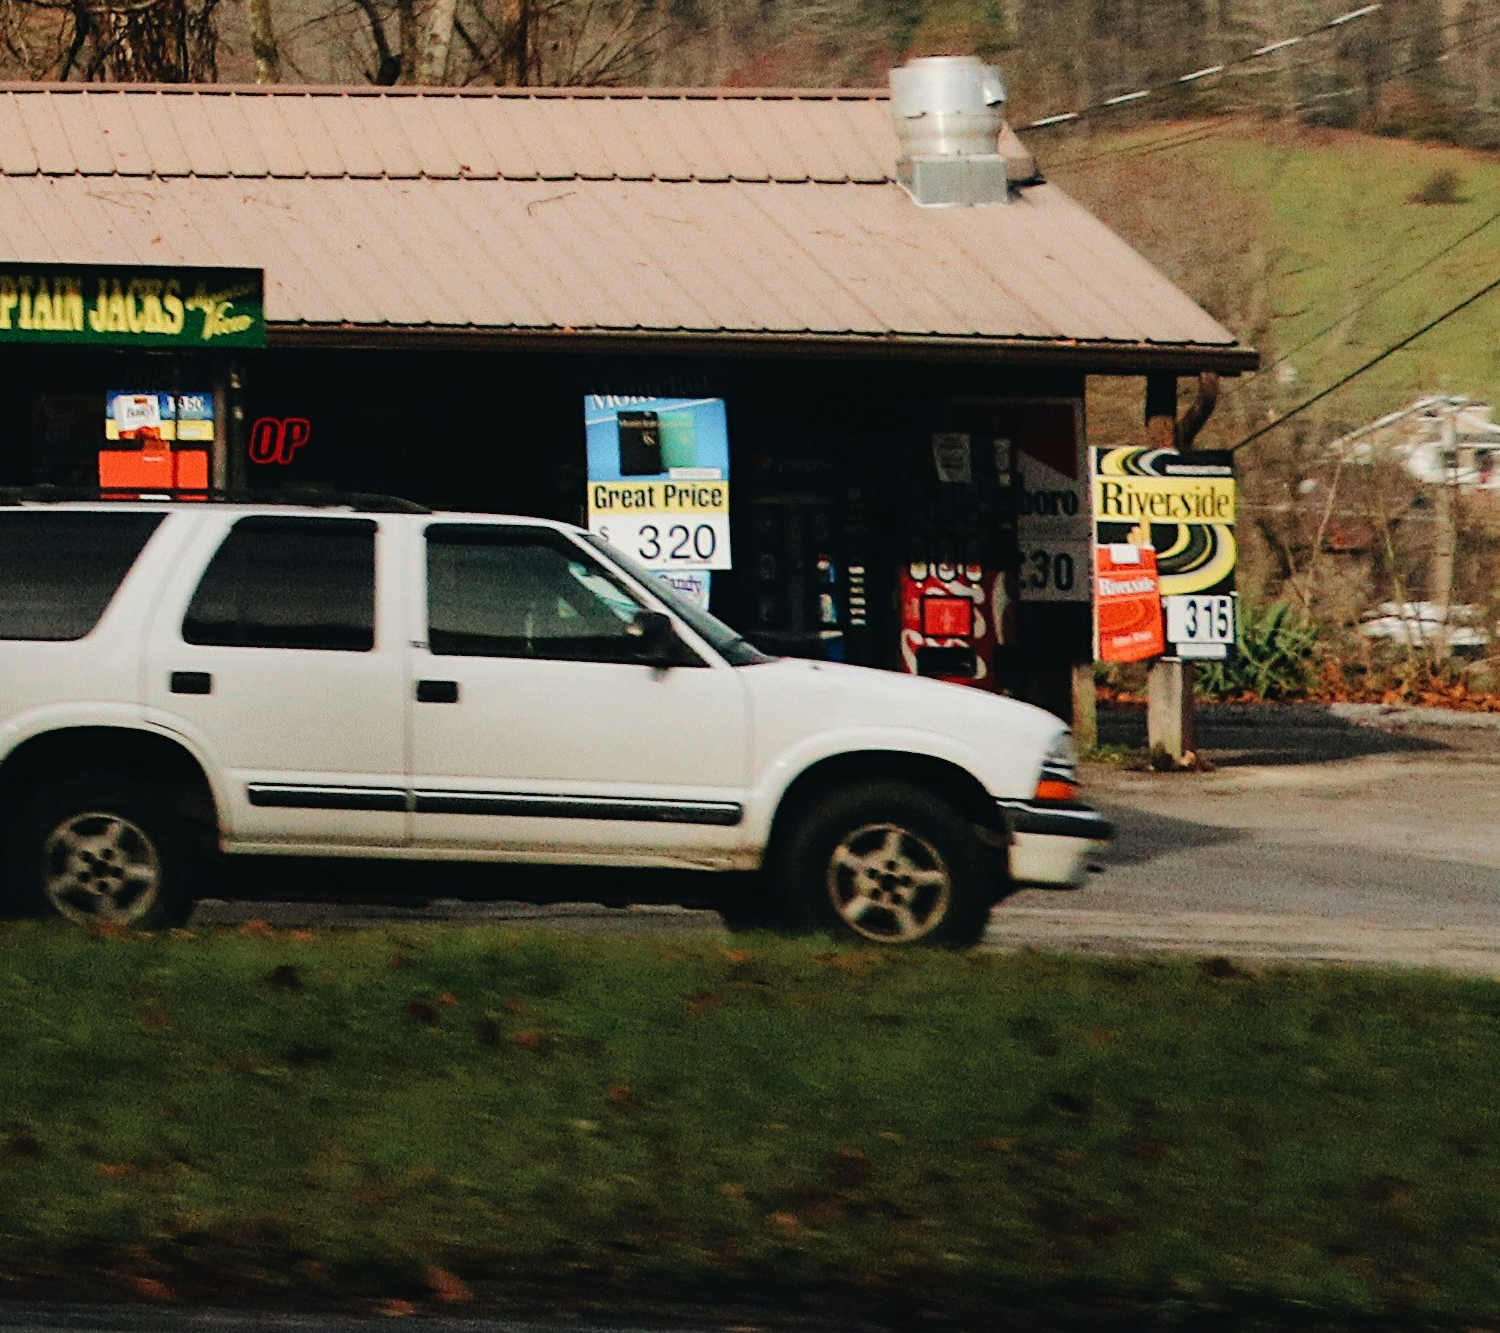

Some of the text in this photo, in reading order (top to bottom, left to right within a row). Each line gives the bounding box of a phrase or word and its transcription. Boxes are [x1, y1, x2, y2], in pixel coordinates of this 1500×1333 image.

[87, 277, 185, 336] JACKS
[594, 484, 723, 510] Great Price
[1099, 481, 1230, 519] Riverside
